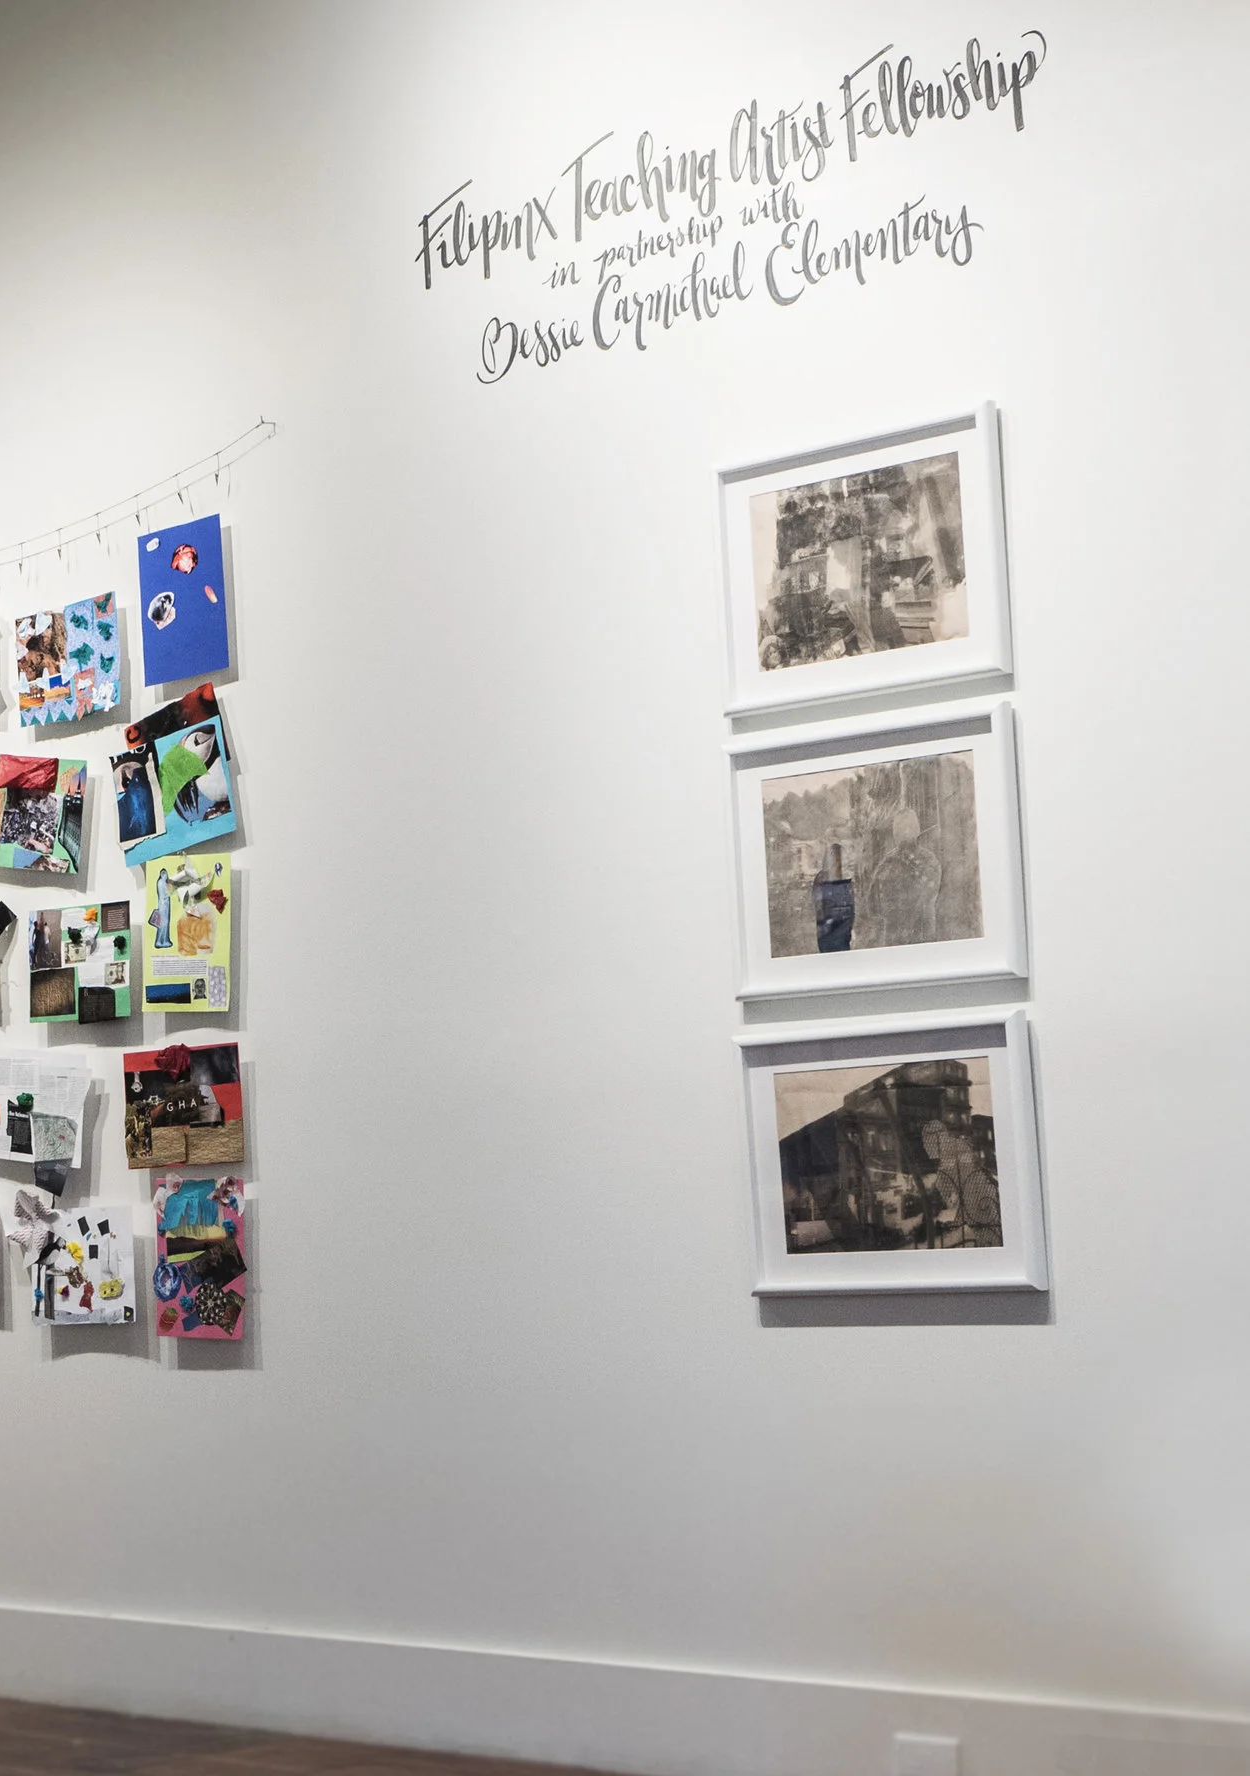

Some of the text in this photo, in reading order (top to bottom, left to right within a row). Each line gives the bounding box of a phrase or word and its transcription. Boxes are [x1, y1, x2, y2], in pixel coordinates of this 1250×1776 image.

[561, 131, 722, 243] Teaching
[729, 99, 834, 186] Artist
[839, 30, 1047, 162] Fellowship
[476, 194, 984, 384] Bessie Carmichael Elementary
[542, 181, 804, 289] in partnership with
